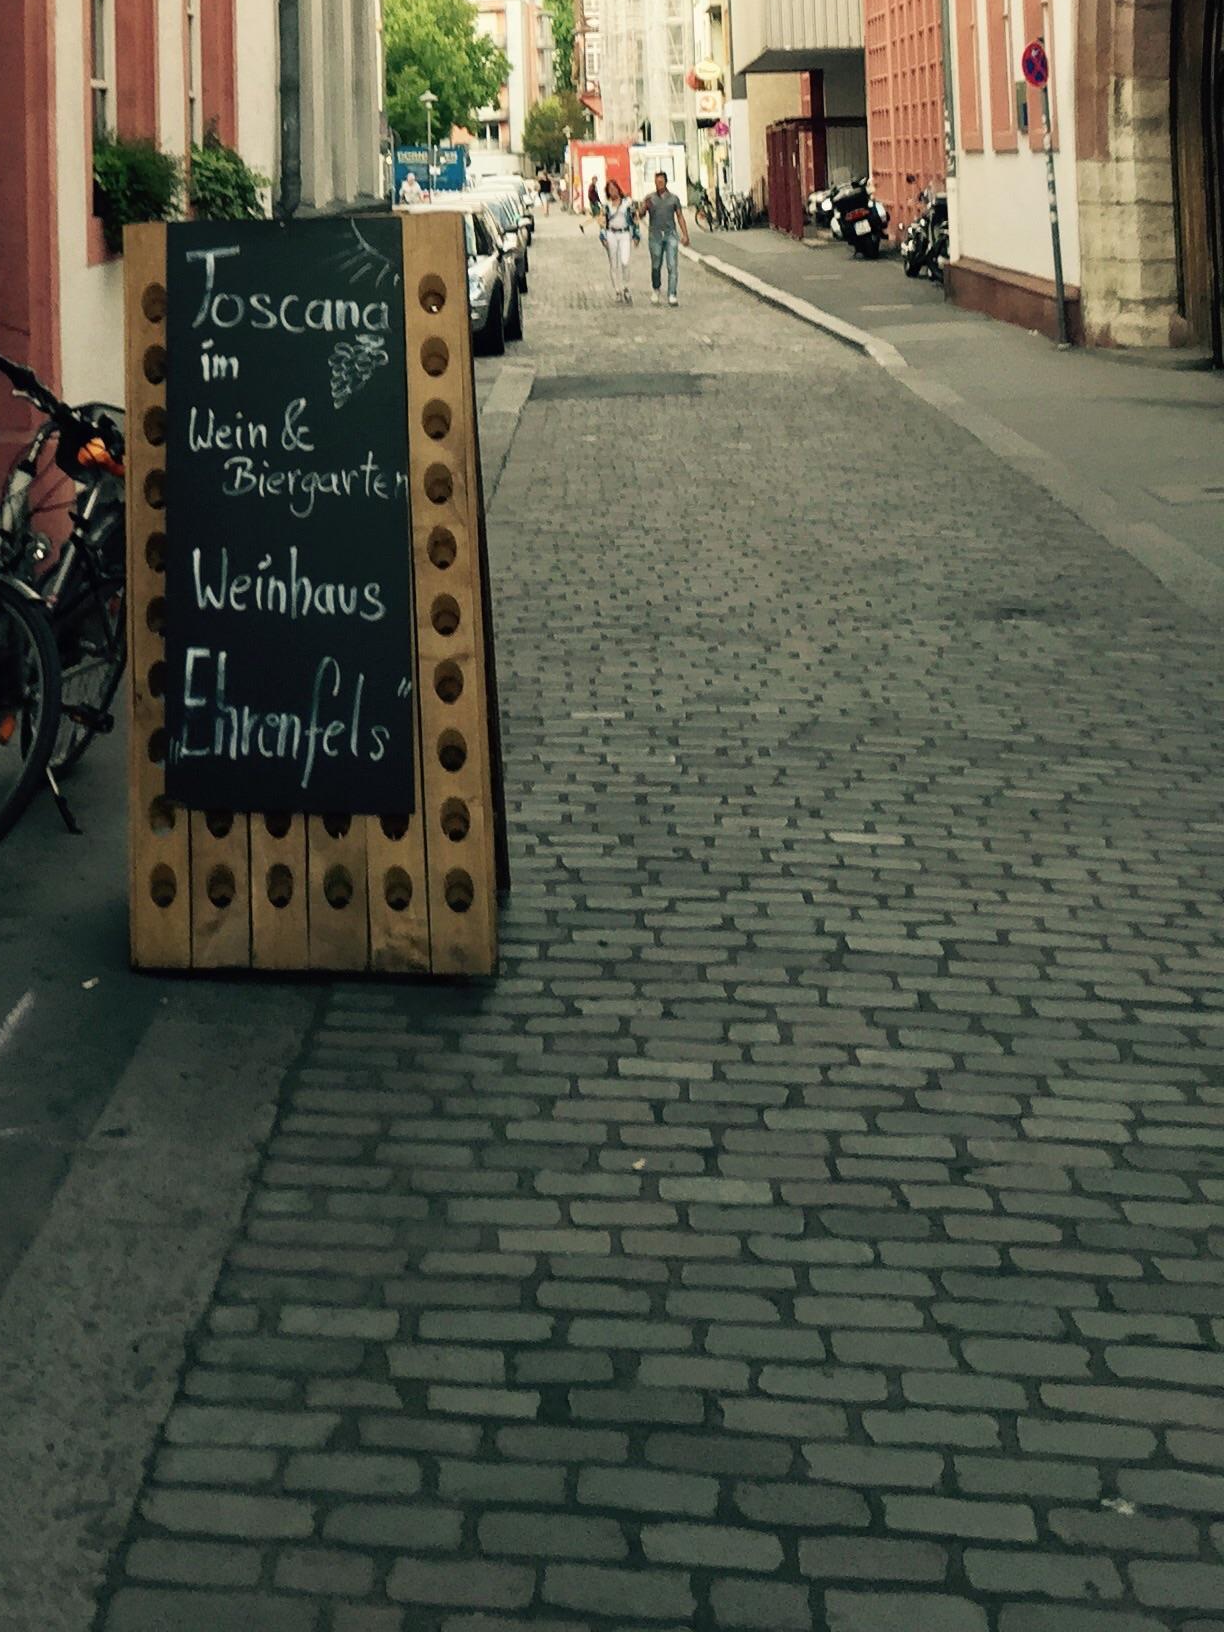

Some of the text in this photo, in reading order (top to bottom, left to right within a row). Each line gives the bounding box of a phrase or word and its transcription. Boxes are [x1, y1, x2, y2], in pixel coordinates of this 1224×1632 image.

[186, 245, 390, 333] Toscana
[200, 338, 239, 381] im
[189, 397, 314, 452] Wein &
[222, 451, 411, 518] Biergarten
[192, 546, 387, 621] Weinhaus
